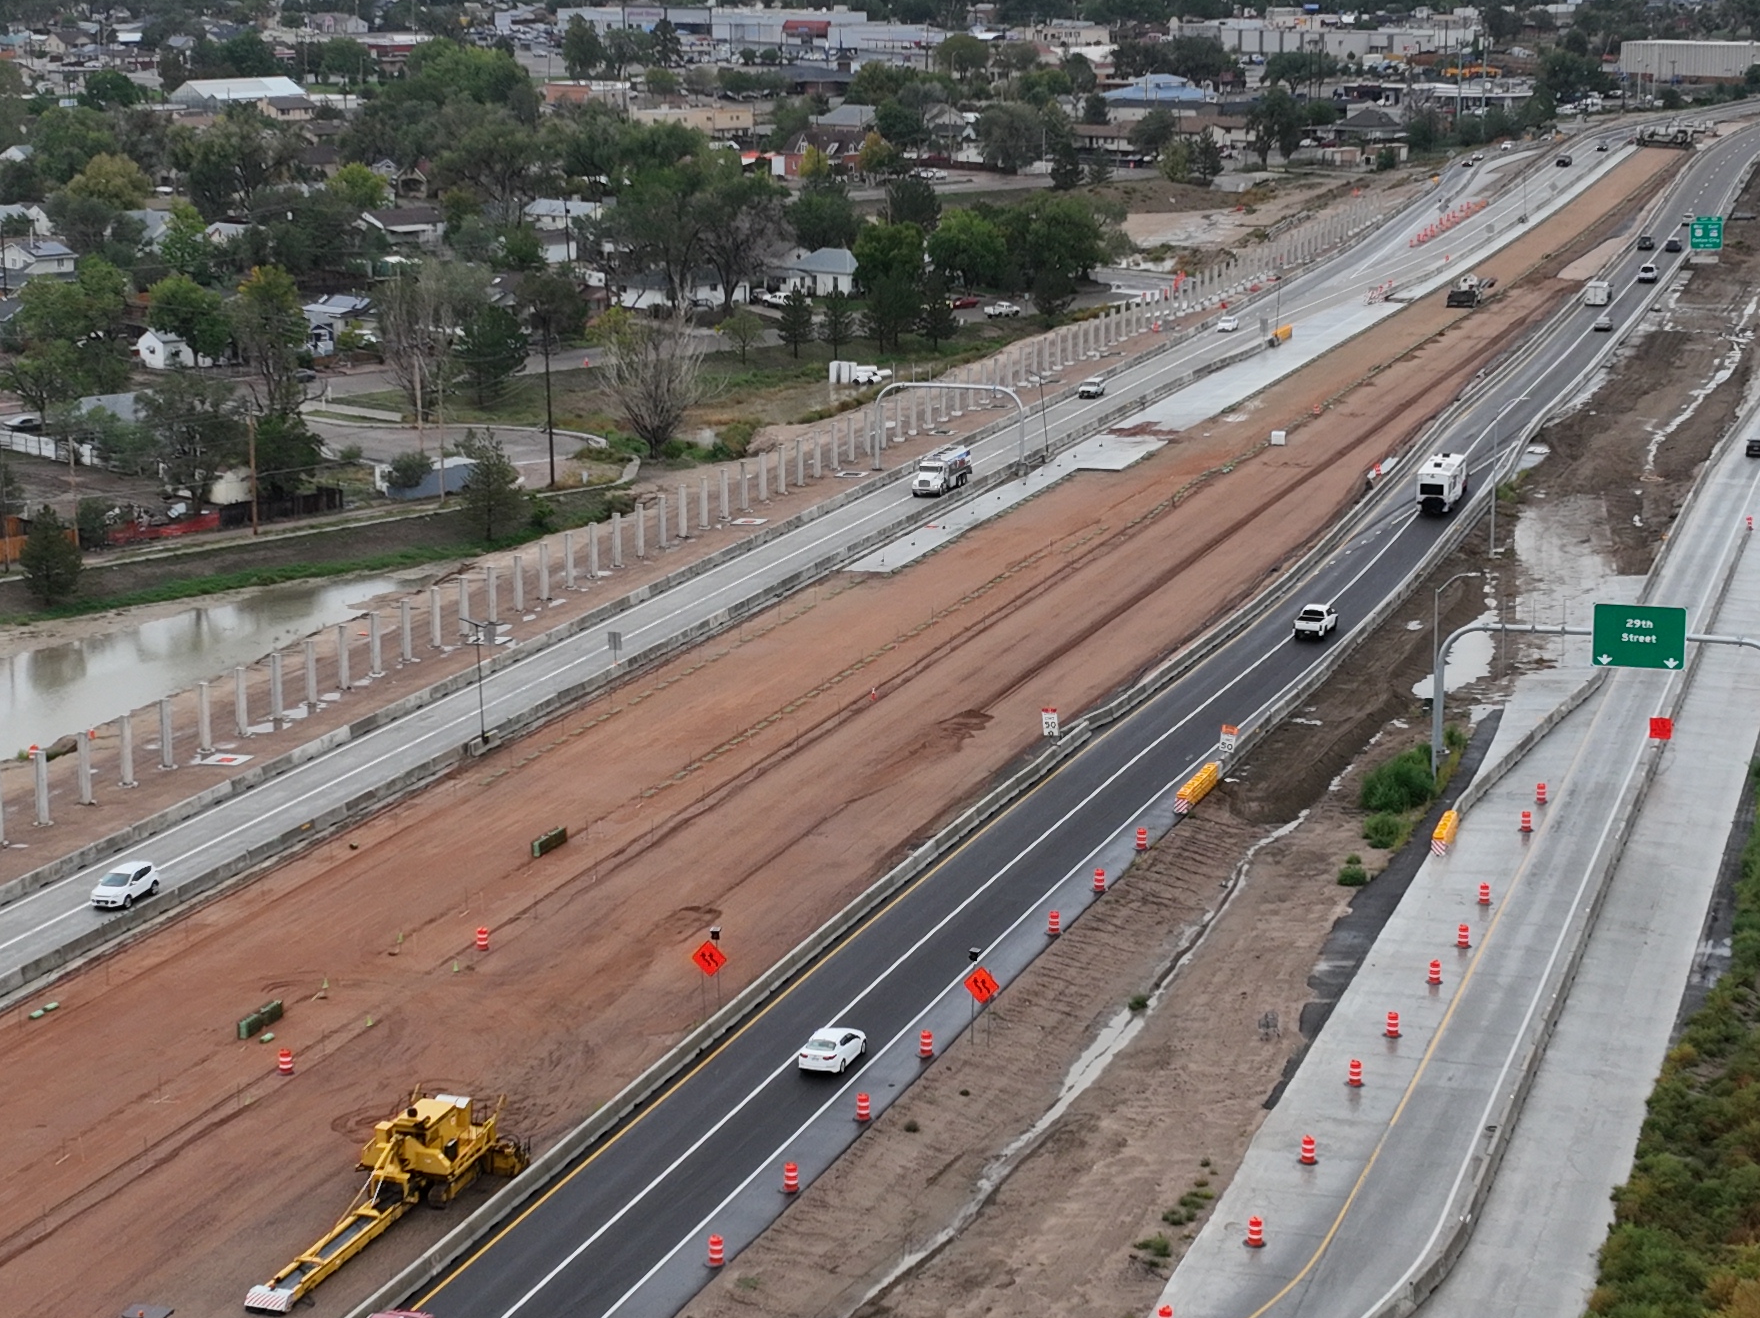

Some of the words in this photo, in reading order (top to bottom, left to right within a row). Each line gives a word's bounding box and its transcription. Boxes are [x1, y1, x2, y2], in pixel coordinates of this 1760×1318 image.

[1625, 618, 1654, 629] 29th
[1621, 633, 1657, 643] Street
[1045, 721, 1056, 729] 50
[1220, 741, 1233, 751] 50
